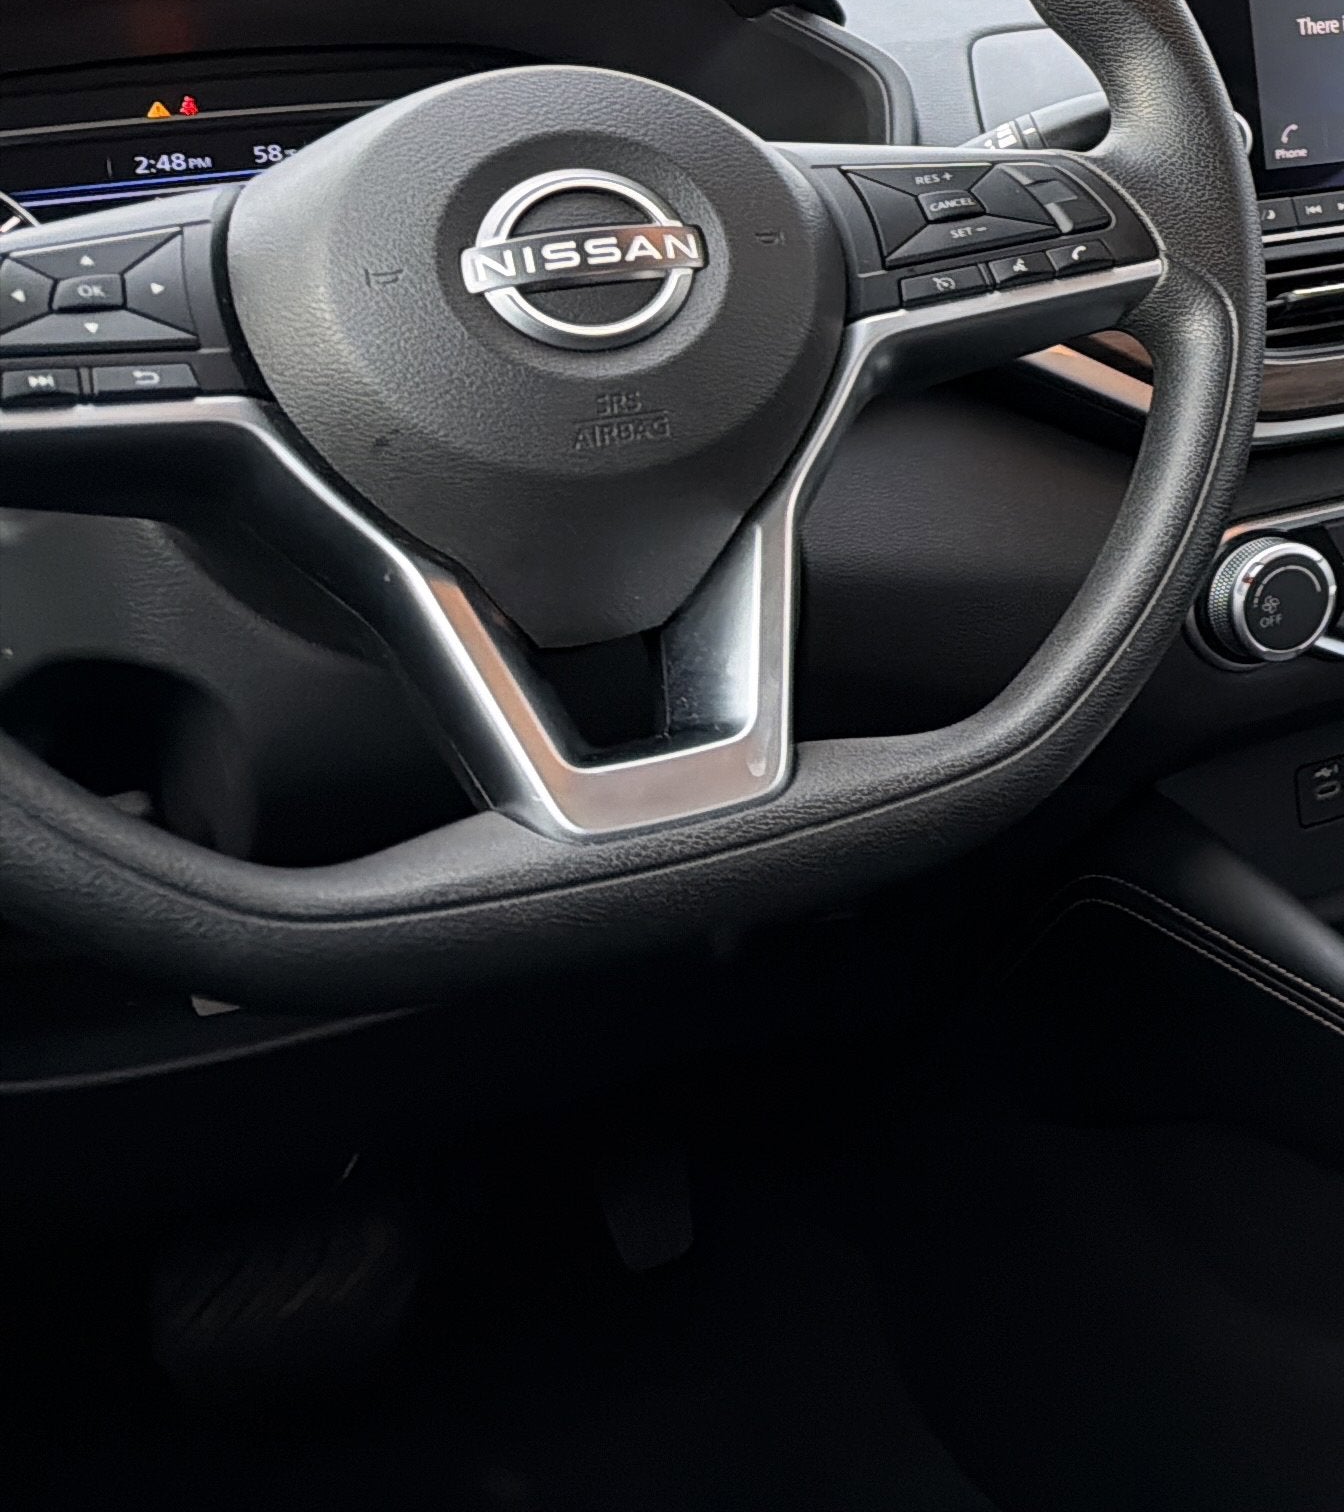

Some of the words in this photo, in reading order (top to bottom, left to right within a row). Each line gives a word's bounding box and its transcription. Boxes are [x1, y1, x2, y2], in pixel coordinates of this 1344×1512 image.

[1297, 16, 1340, 35] There
[1275, 144, 1308, 160] Phone
[915, 173, 940, 185] RES
[930, 197, 976, 212] CANCEL
[950, 226, 972, 239] SET
[472, 233, 699, 281] NISSAN
[77, 284, 106, 298] OK
[596, 391, 642, 416] SRS
[573, 414, 673, 449] AIRBAG
[1259, 613, 1282, 628] OFF
